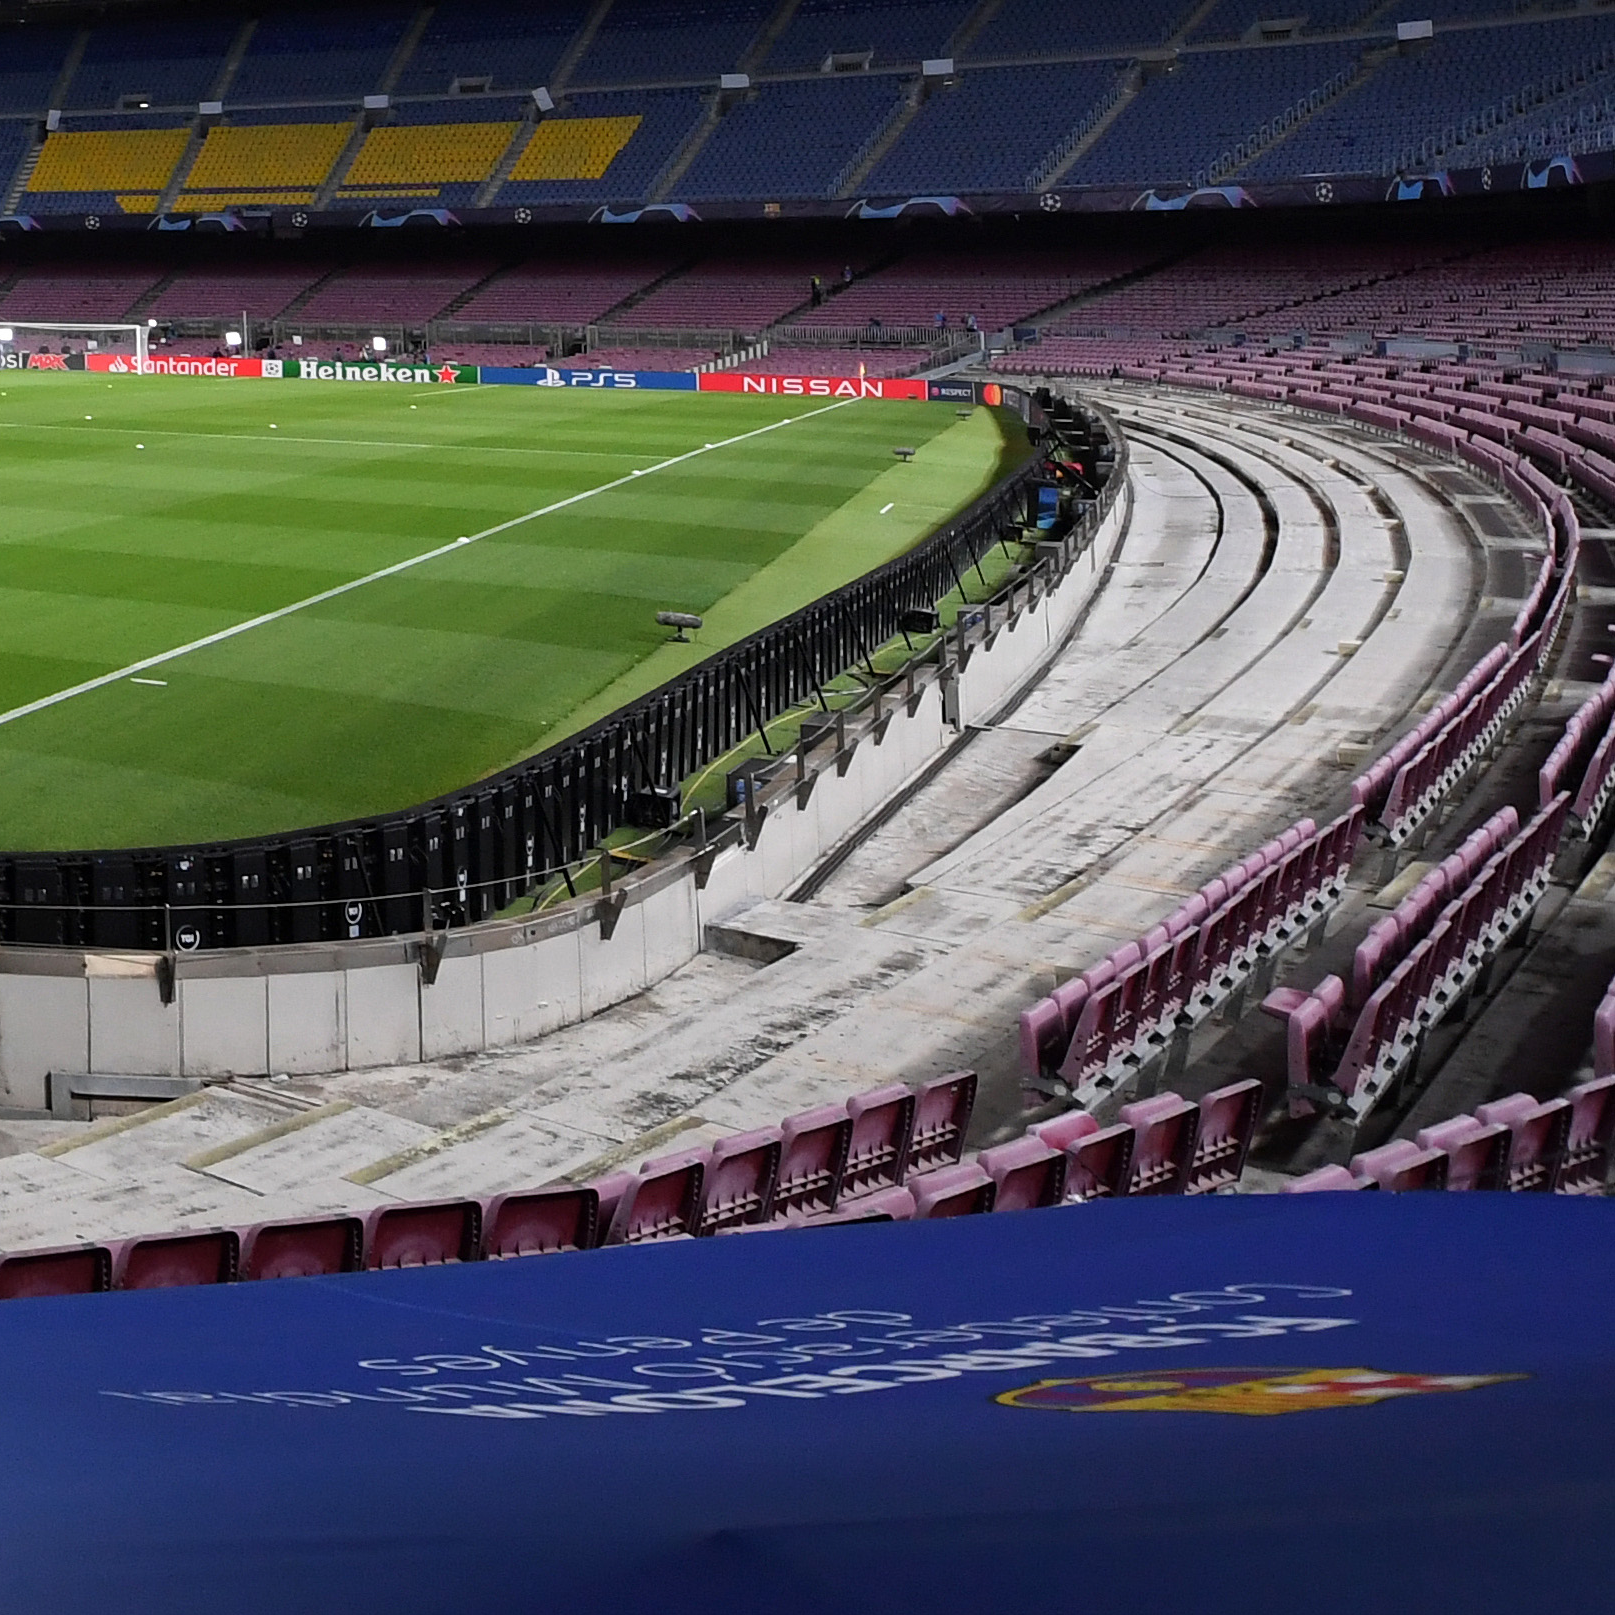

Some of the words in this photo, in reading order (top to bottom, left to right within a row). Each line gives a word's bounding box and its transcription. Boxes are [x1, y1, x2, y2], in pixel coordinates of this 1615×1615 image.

[27, 353, 70, 370] MAX
[130, 356, 239, 376] Santander
[299, 360, 432, 383] Heineken
[570, 371, 637, 388] PS5
[742, 376, 883, 398] NISSAN
[941, 387, 972, 397] RESPECT
[757, 1309, 913, 1331] de
[1148, 1315, 1357, 1338] FC
[633, 1283, 1353, 1381] Confederació
[359, 1328, 787, 1375] Penyes
[406, 1333, 1209, 1419] BARCELONA
[99, 1374, 651, 1409] Mundial
